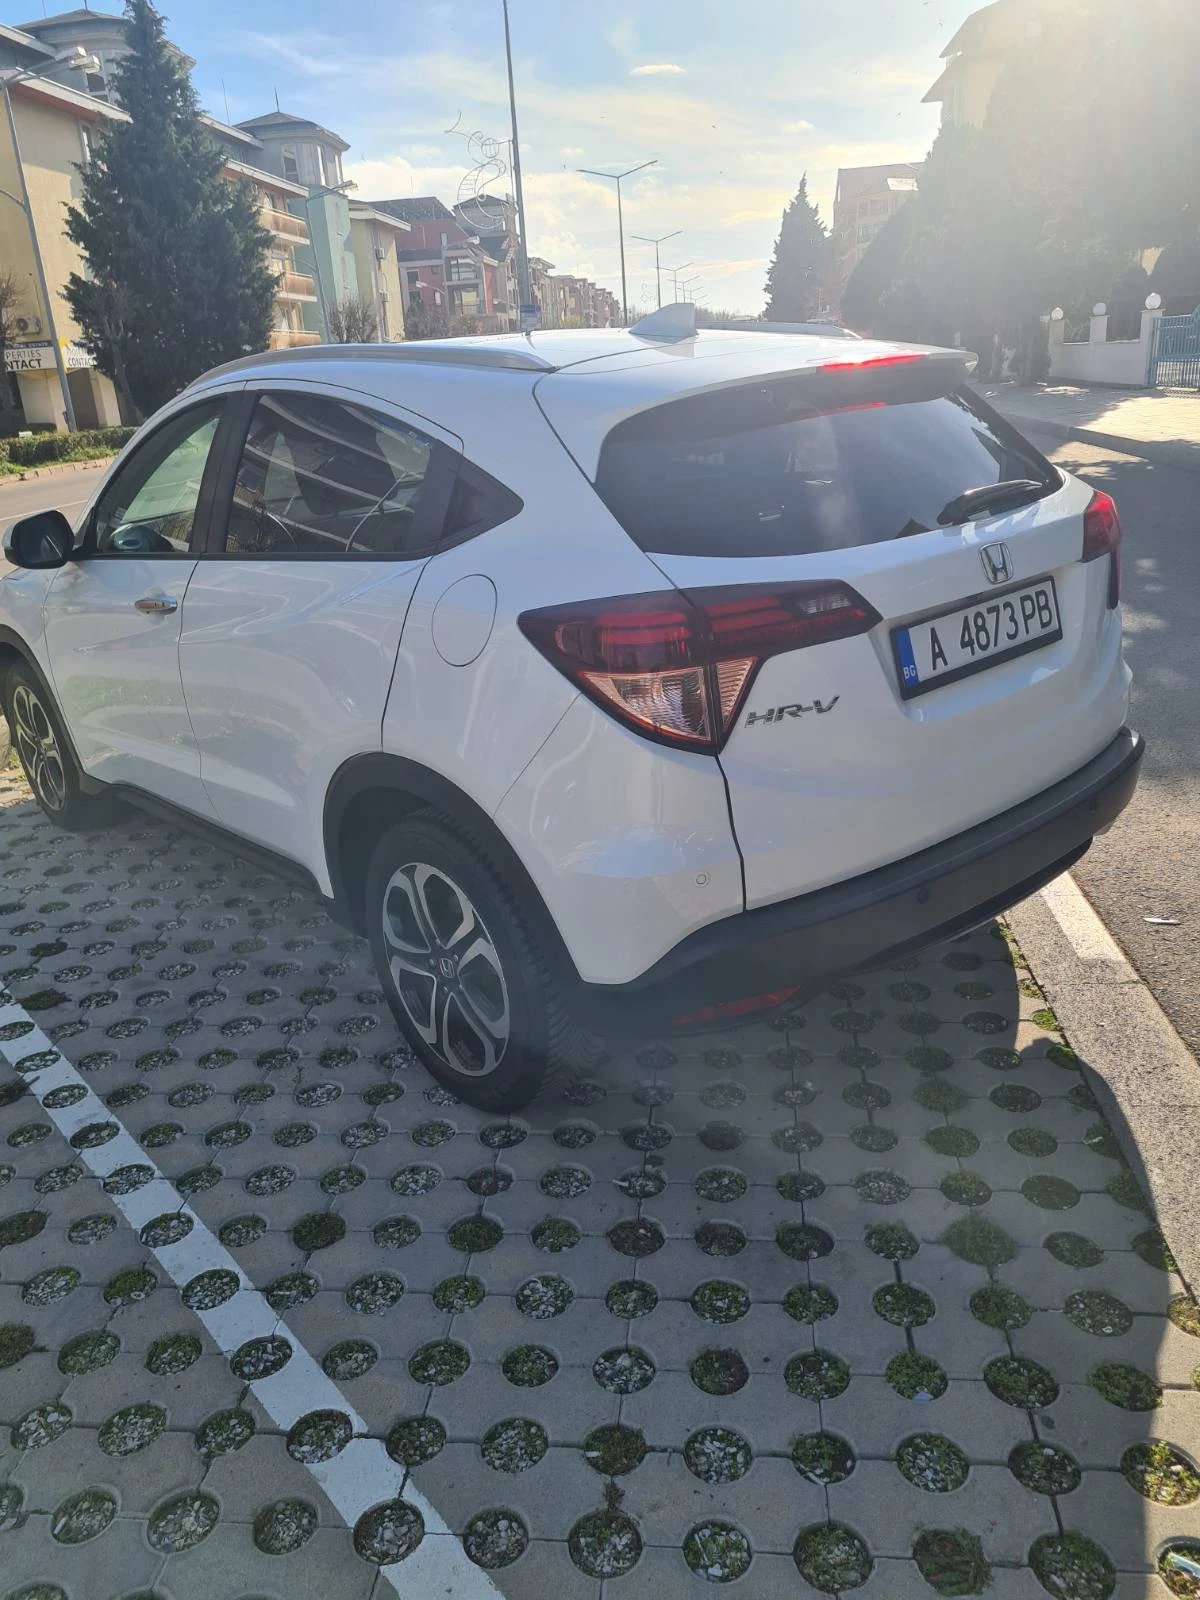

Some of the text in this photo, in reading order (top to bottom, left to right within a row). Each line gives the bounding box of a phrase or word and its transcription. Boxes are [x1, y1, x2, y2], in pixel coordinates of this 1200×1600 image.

[5, 349, 42, 360] PERTIES
[5, 358, 42, 370] NTACT
[930, 626, 949, 671] A
[903, 663, 917, 680] BG
[744, 695, 840, 728] HR-V
